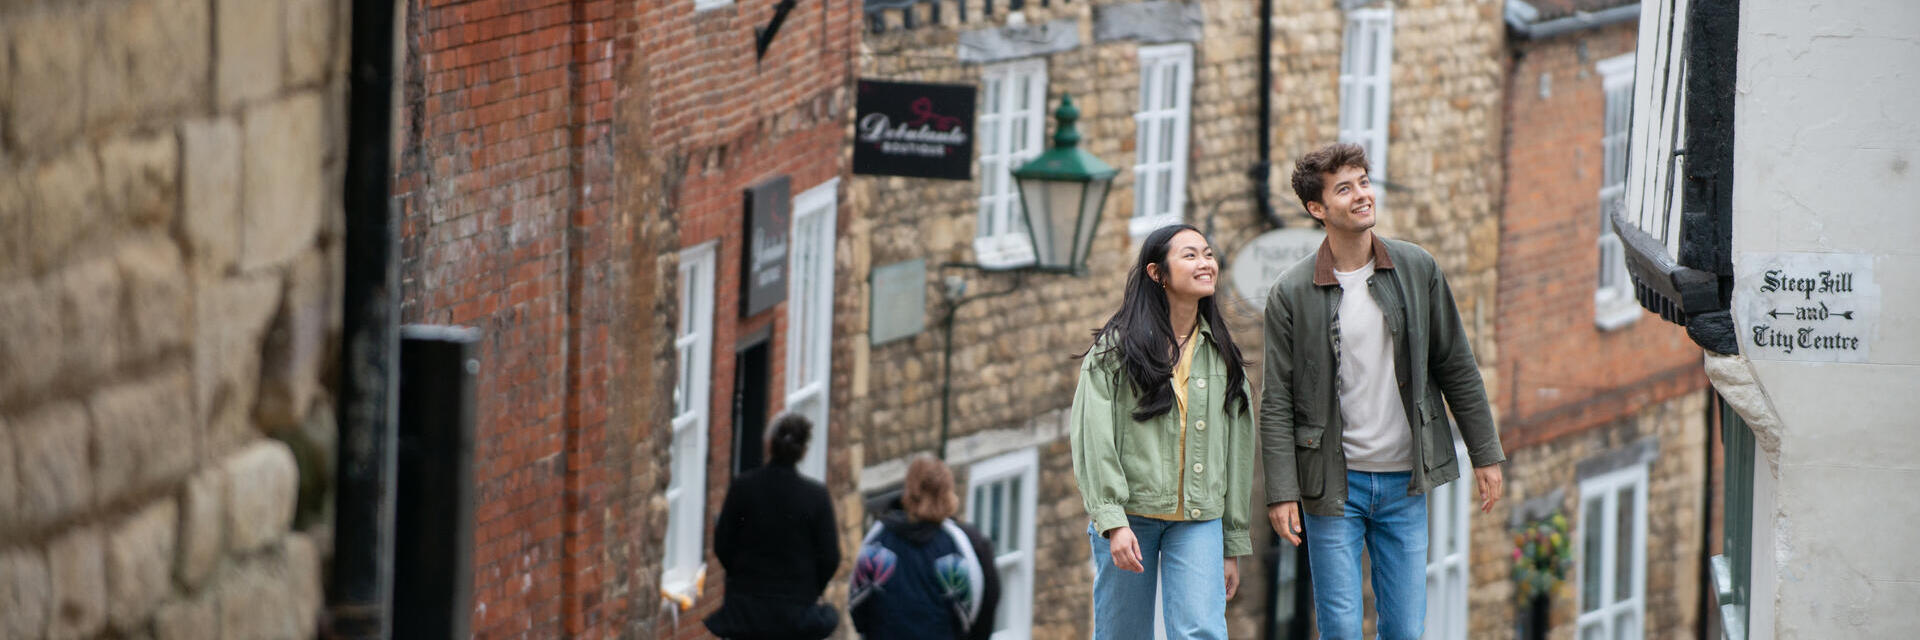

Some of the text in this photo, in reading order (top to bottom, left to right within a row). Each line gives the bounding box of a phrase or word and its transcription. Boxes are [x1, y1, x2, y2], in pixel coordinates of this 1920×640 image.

[860, 112, 967, 143] Debutante
[881, 141, 945, 156] BOUTIQUE
[1760, 269, 1853, 300] Steep Hill
[1795, 301, 1829, 321] and
[1752, 324, 1859, 354] City Centre
